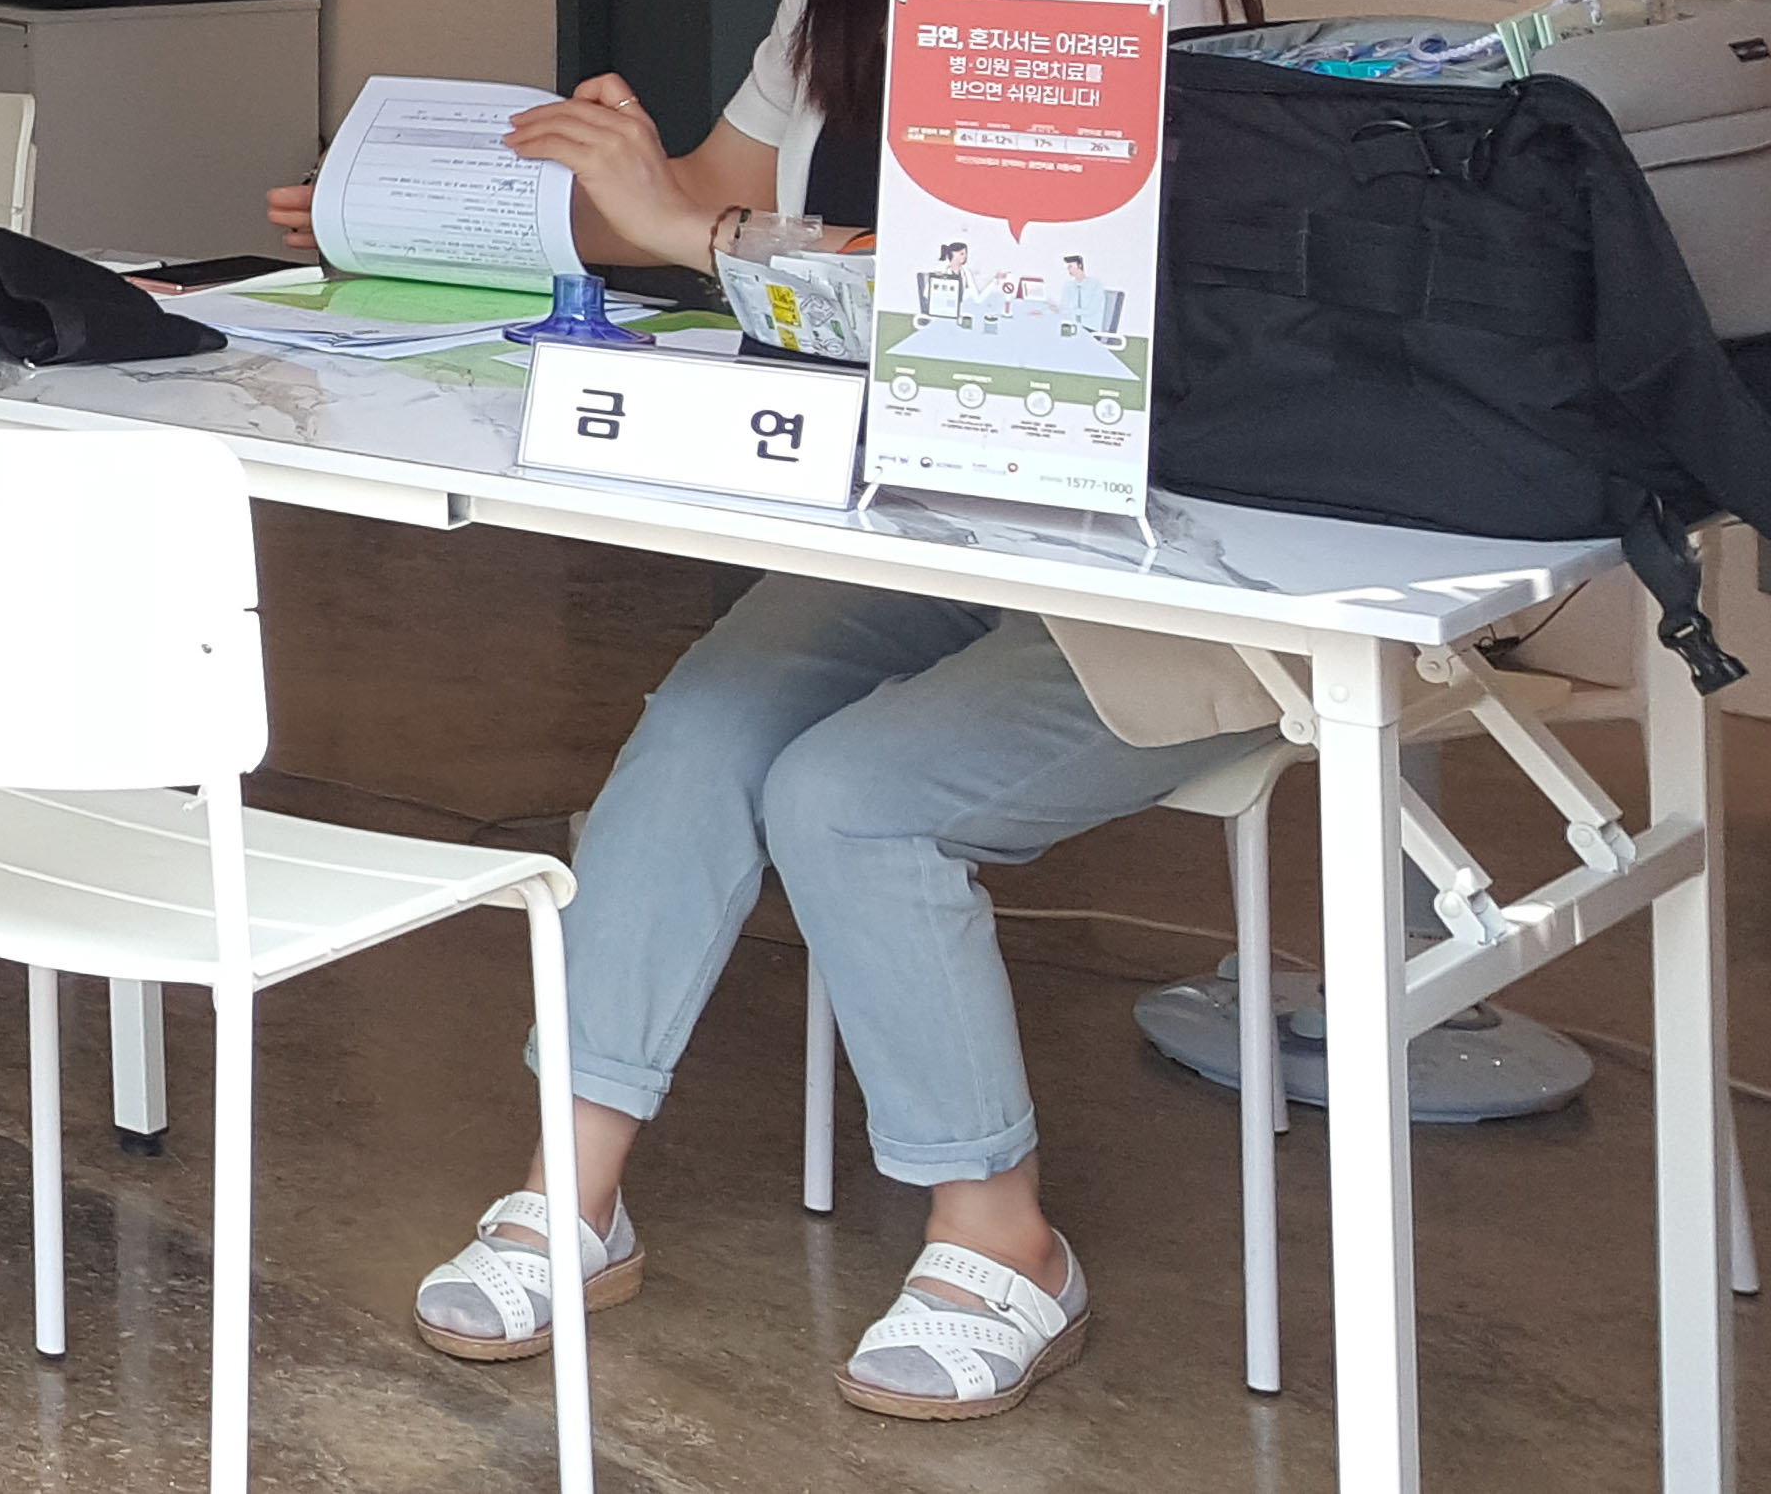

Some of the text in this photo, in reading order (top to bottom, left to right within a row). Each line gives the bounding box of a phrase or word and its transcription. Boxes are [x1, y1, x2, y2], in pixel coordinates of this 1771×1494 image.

[917, 24, 1140, 58] 금연, 혼자서는 어려워도
[1013, 59, 1103, 82] 금연치료를
[950, 80, 1100, 106] 받으면 쉬워집니다!
[1066, 476, 1134, 495] 1577-1000
